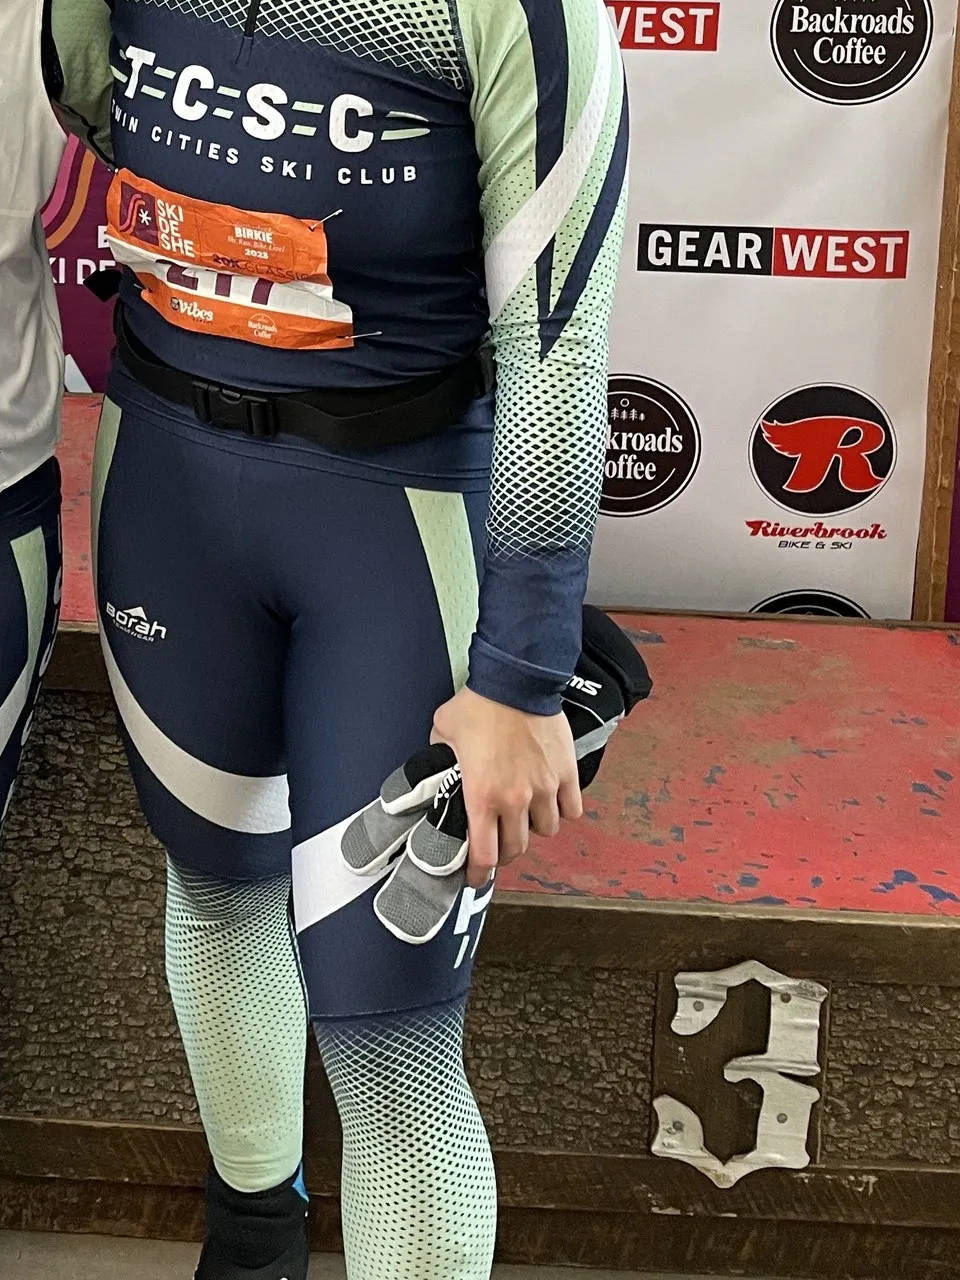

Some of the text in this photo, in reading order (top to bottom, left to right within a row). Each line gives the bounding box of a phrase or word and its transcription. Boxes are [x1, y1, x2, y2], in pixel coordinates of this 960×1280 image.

[790, 6, 914, 35] Backroads
[813, 37, 886, 65] Coffee
[151, 126, 239, 164] CITIES
[261, 156, 311, 179] SKI
[338, 166, 417, 184] CLUB
[157, 199, 183, 222] SKI
[158, 219, 181, 238] DE
[234, 226, 273, 244] BIRKIE
[160, 233, 195, 258] SHE
[245, 248, 269, 260] 2023
[647, 230, 903, 273] GEAR WEST
[606, 424, 683, 453] kroads
[604, 453, 657, 480] offee
[746, 521, 887, 540] Riverbrook
[778, 541, 853, 549] BIKE & SKI
